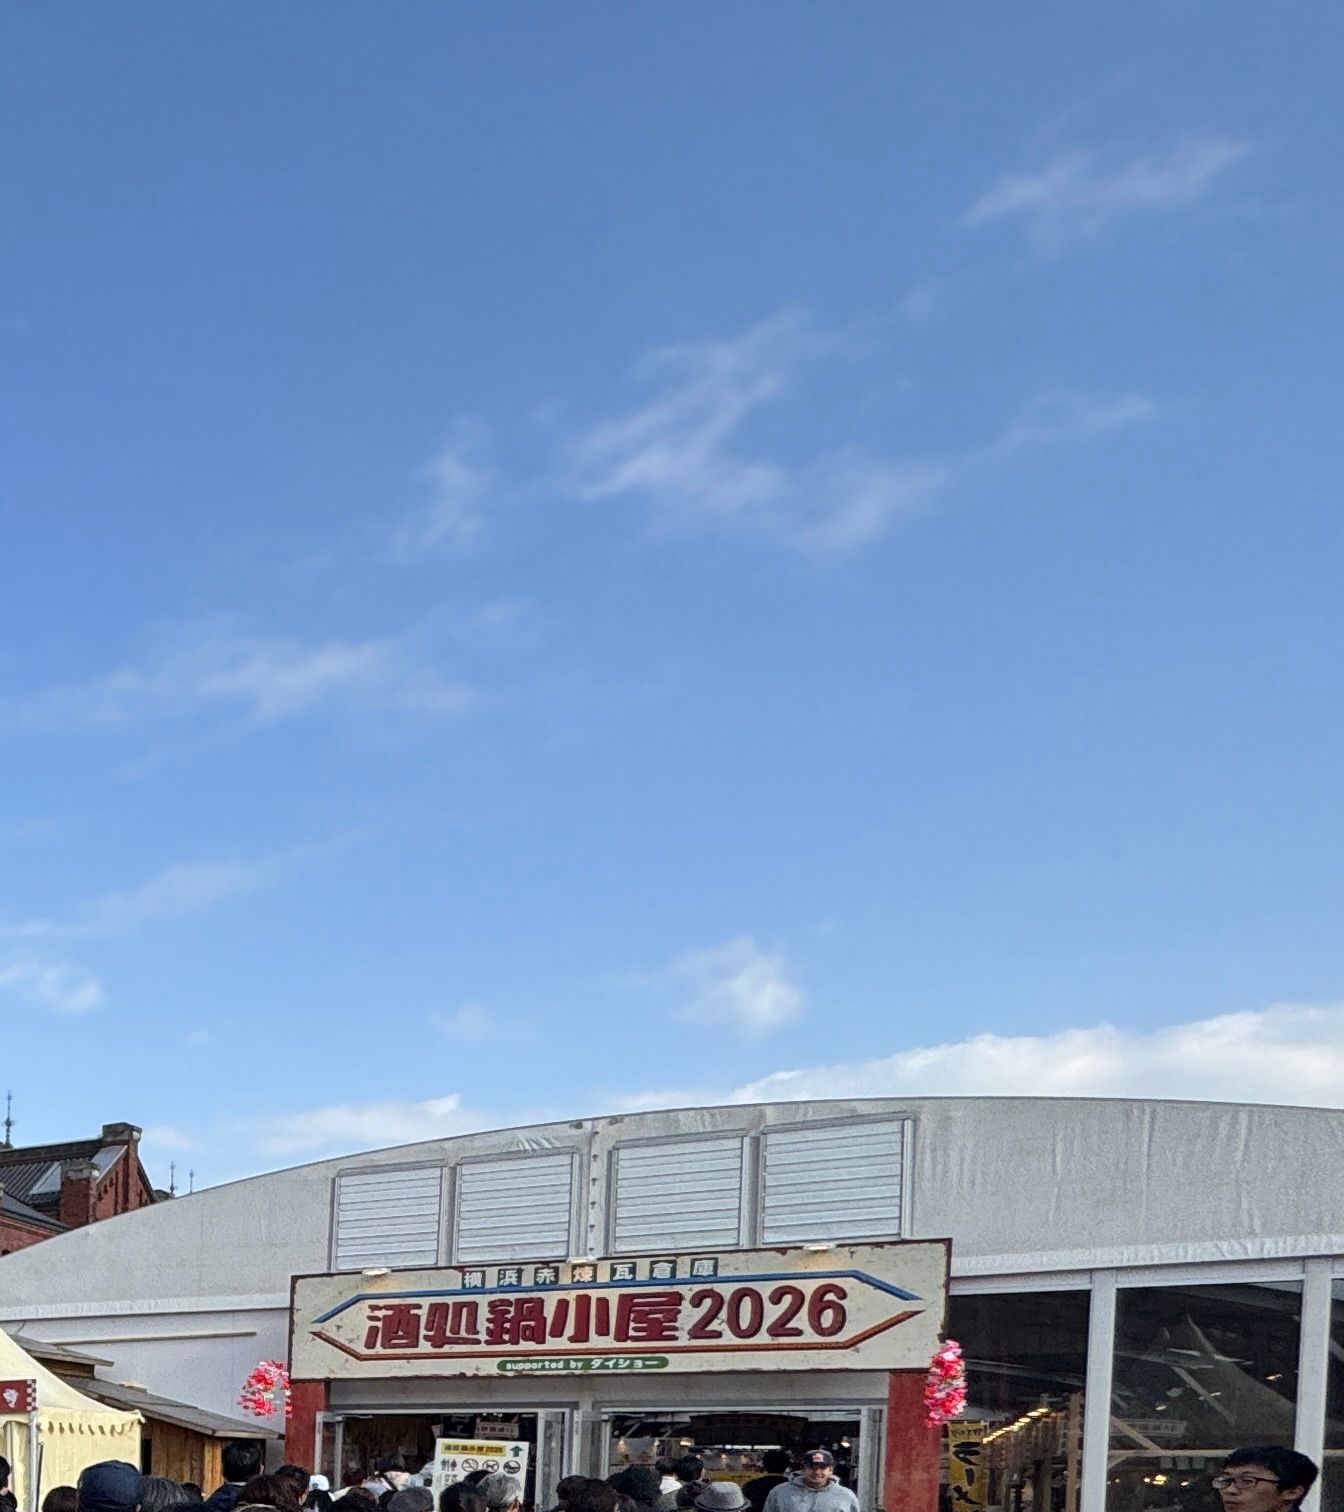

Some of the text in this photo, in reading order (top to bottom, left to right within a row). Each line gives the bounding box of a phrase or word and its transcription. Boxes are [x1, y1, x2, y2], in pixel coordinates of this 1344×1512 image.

[463, 1258, 717, 1288] 横浜赤煉瓦倉庫
[505, 1357, 659, 1371] supported by ダイショー
